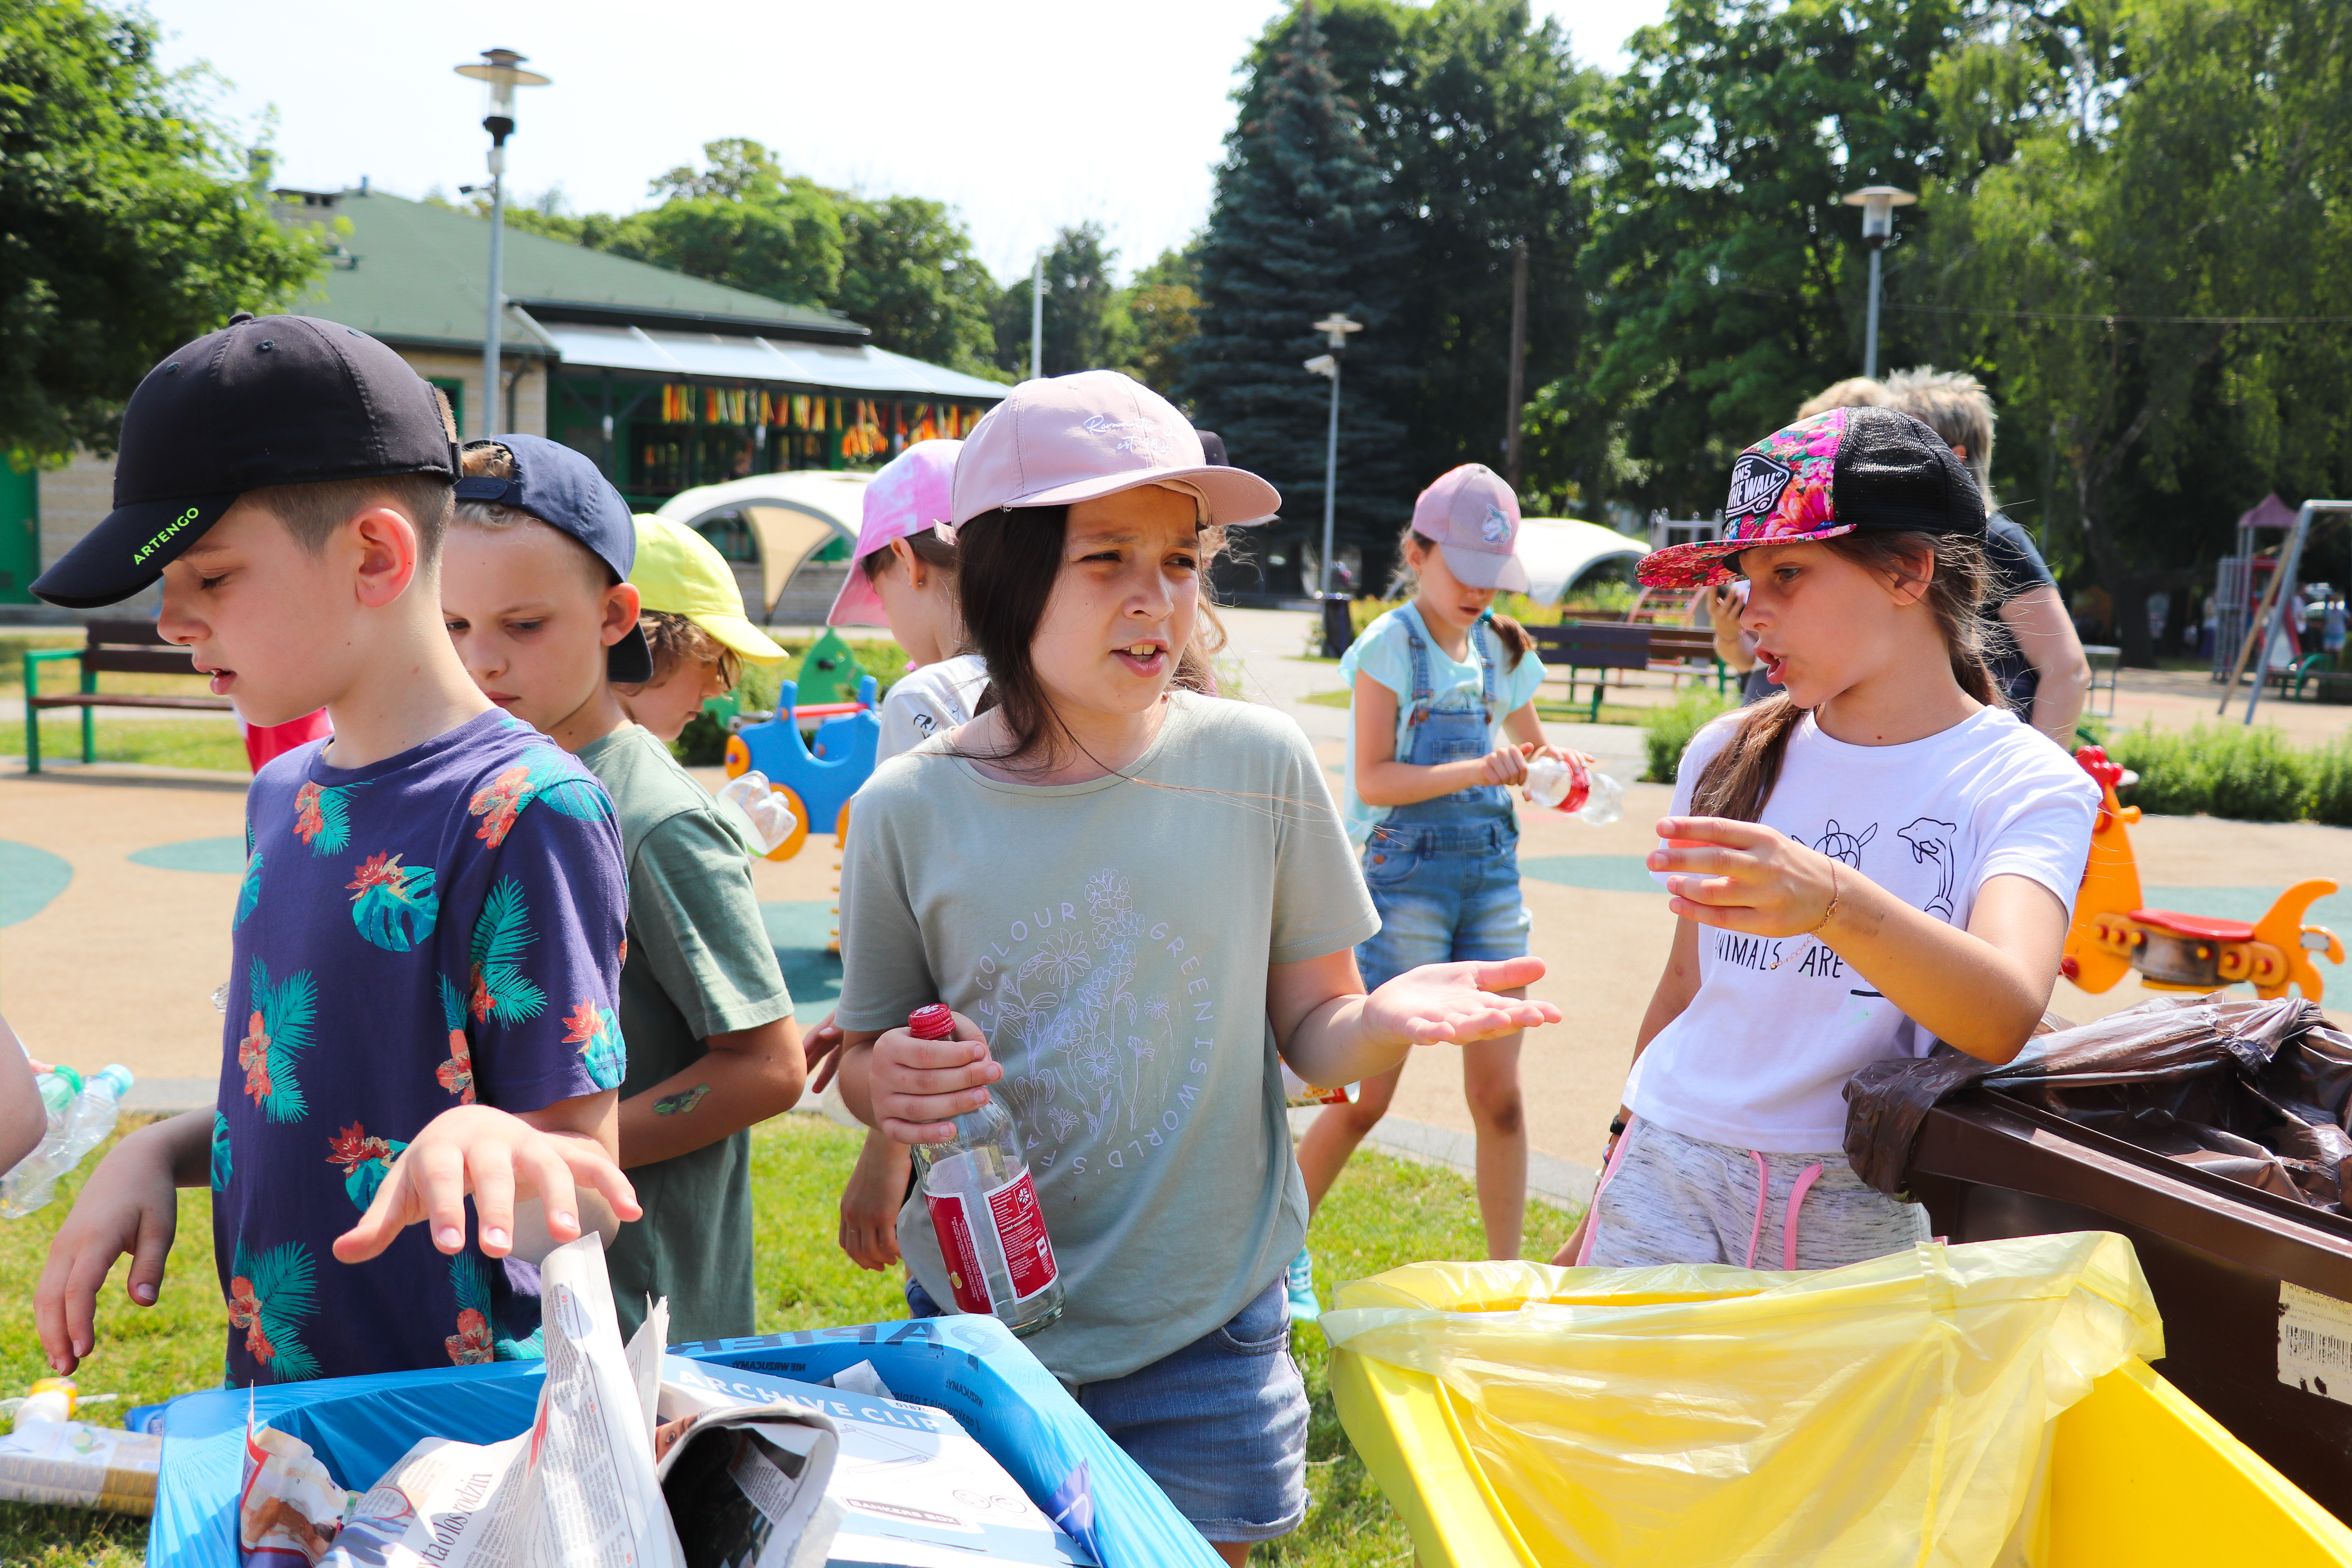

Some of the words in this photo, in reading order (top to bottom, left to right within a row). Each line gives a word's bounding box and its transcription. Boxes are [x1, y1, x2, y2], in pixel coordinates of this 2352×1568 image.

[134, 508, 199, 564] ARTENGO
[914, 714, 938, 731] FRI
[1798, 946, 1843, 978] ARE
[999, 1212, 1034, 1234] social-economy.pl
[680, 1370, 855, 1416] ARCHIVE
[861, 1408, 940, 1430] CLIP
[452, 1473, 494, 1515] rodzin
[434, 1513, 468, 1535] los
[849, 1499, 924, 1518] BANKERS
[924, 1513, 957, 1524] BOX
[435, 1532, 455, 1545] o
